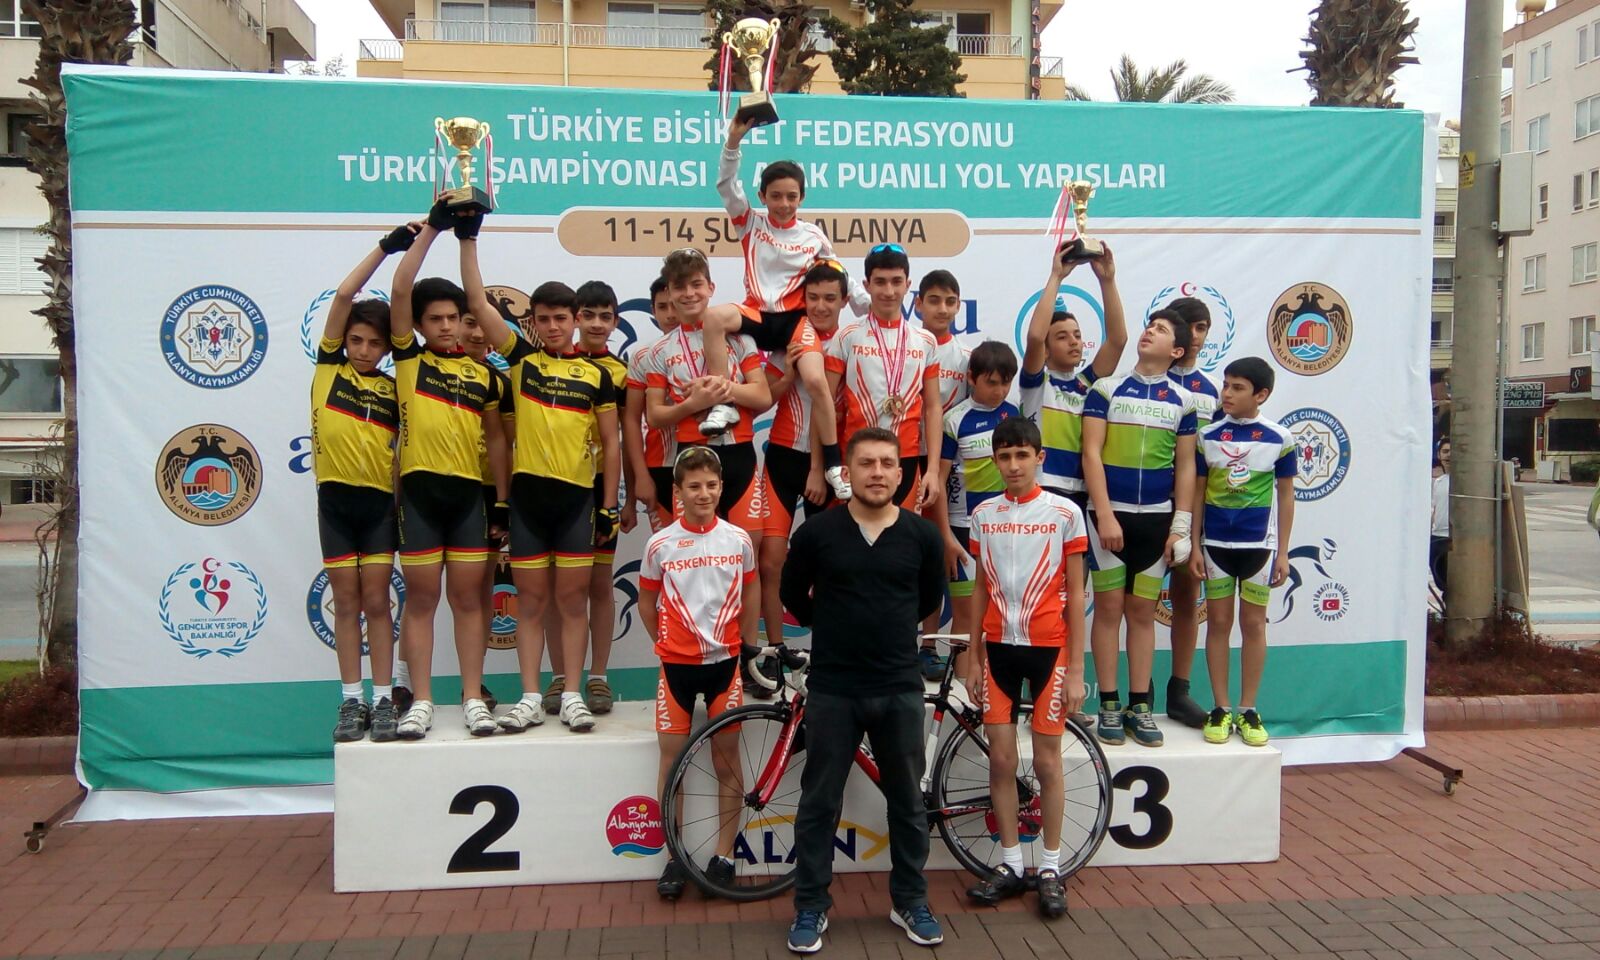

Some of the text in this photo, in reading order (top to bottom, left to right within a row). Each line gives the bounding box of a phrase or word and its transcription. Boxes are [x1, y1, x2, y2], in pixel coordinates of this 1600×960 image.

[507, 107, 643, 142] TÜRKİYE
[796, 120, 1014, 148] FEDERASYONU
[491, 151, 707, 195] ŞAMPİYONASI
[838, 162, 946, 189] PUANLI
[955, 163, 1010, 189] YOL
[604, 217, 694, 243] 11-14
[166, 288, 264, 325] TÜRKİYE CUMHURİYETİ
[165, 349, 264, 387] ALANYA KAYMAKAMLIĞI
[1276, 346, 1342, 371] ALANYA BELEDİYESİ
[199, 427, 219, 435] T.C.
[1299, 410, 1348, 443] CUMHURİYETİ
[169, 493, 251, 520] ALANYA BELEDİYESİ
[661, 554, 743, 574] TAŞKENTSPOR
[177, 621, 249, 632] GENÇLİK VE SPOR
[190, 630, 236, 640] BAKANLIĞI
[657, 678, 672, 731] KONYA
[1047, 666, 1068, 724] KONYA
[626, 804, 649, 821] Bir
[1109, 765, 1173, 850] 3
[446, 784, 520, 874] 2
[628, 832, 647, 841] var
